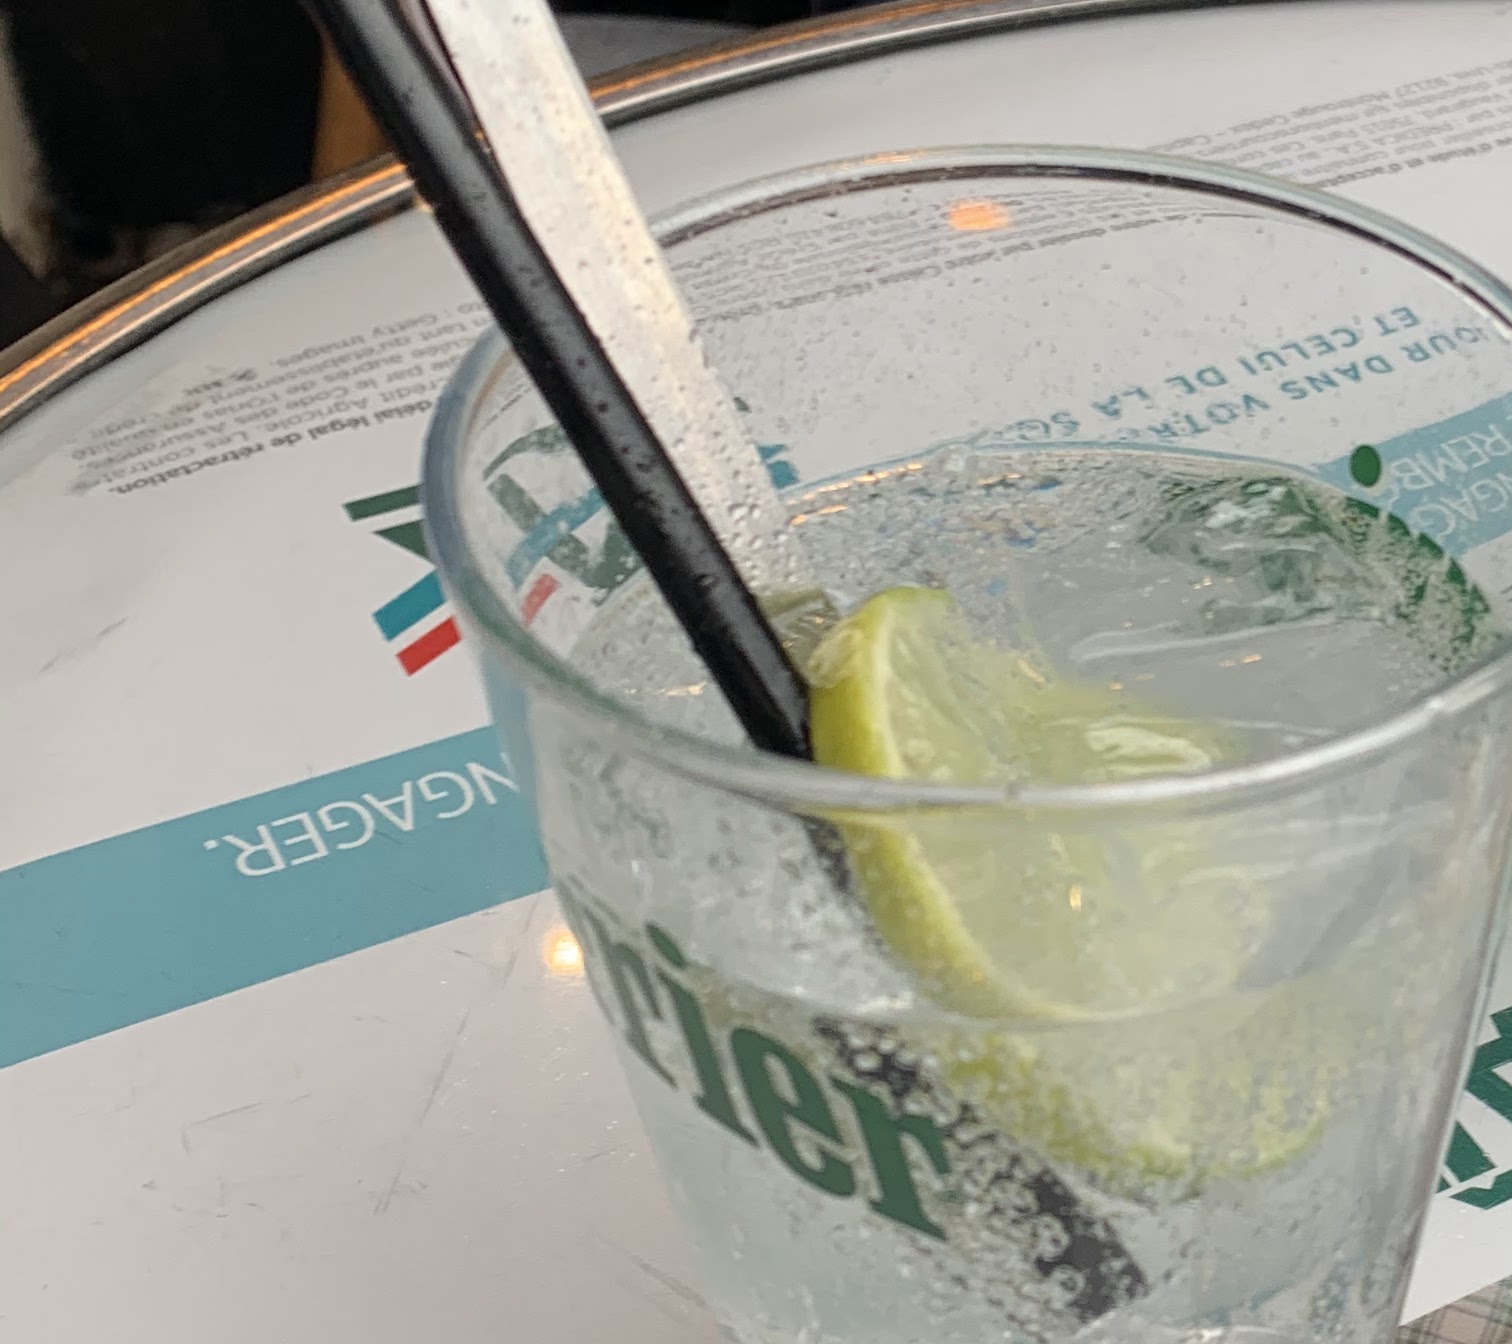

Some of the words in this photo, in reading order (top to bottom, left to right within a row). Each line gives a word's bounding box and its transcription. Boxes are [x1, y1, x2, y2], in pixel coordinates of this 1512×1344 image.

[1372, 306, 1421, 337] ET
[1237, 326, 1359, 377] CELUI
[1278, 354, 1394, 400] DANS
[307, 415, 370, 440] légal
[374, 400, 432, 424] délai
[269, 432, 302, 447] de
[1387, 424, 1512, 504] REMB
[203, 753, 519, 877] NGAGER.
